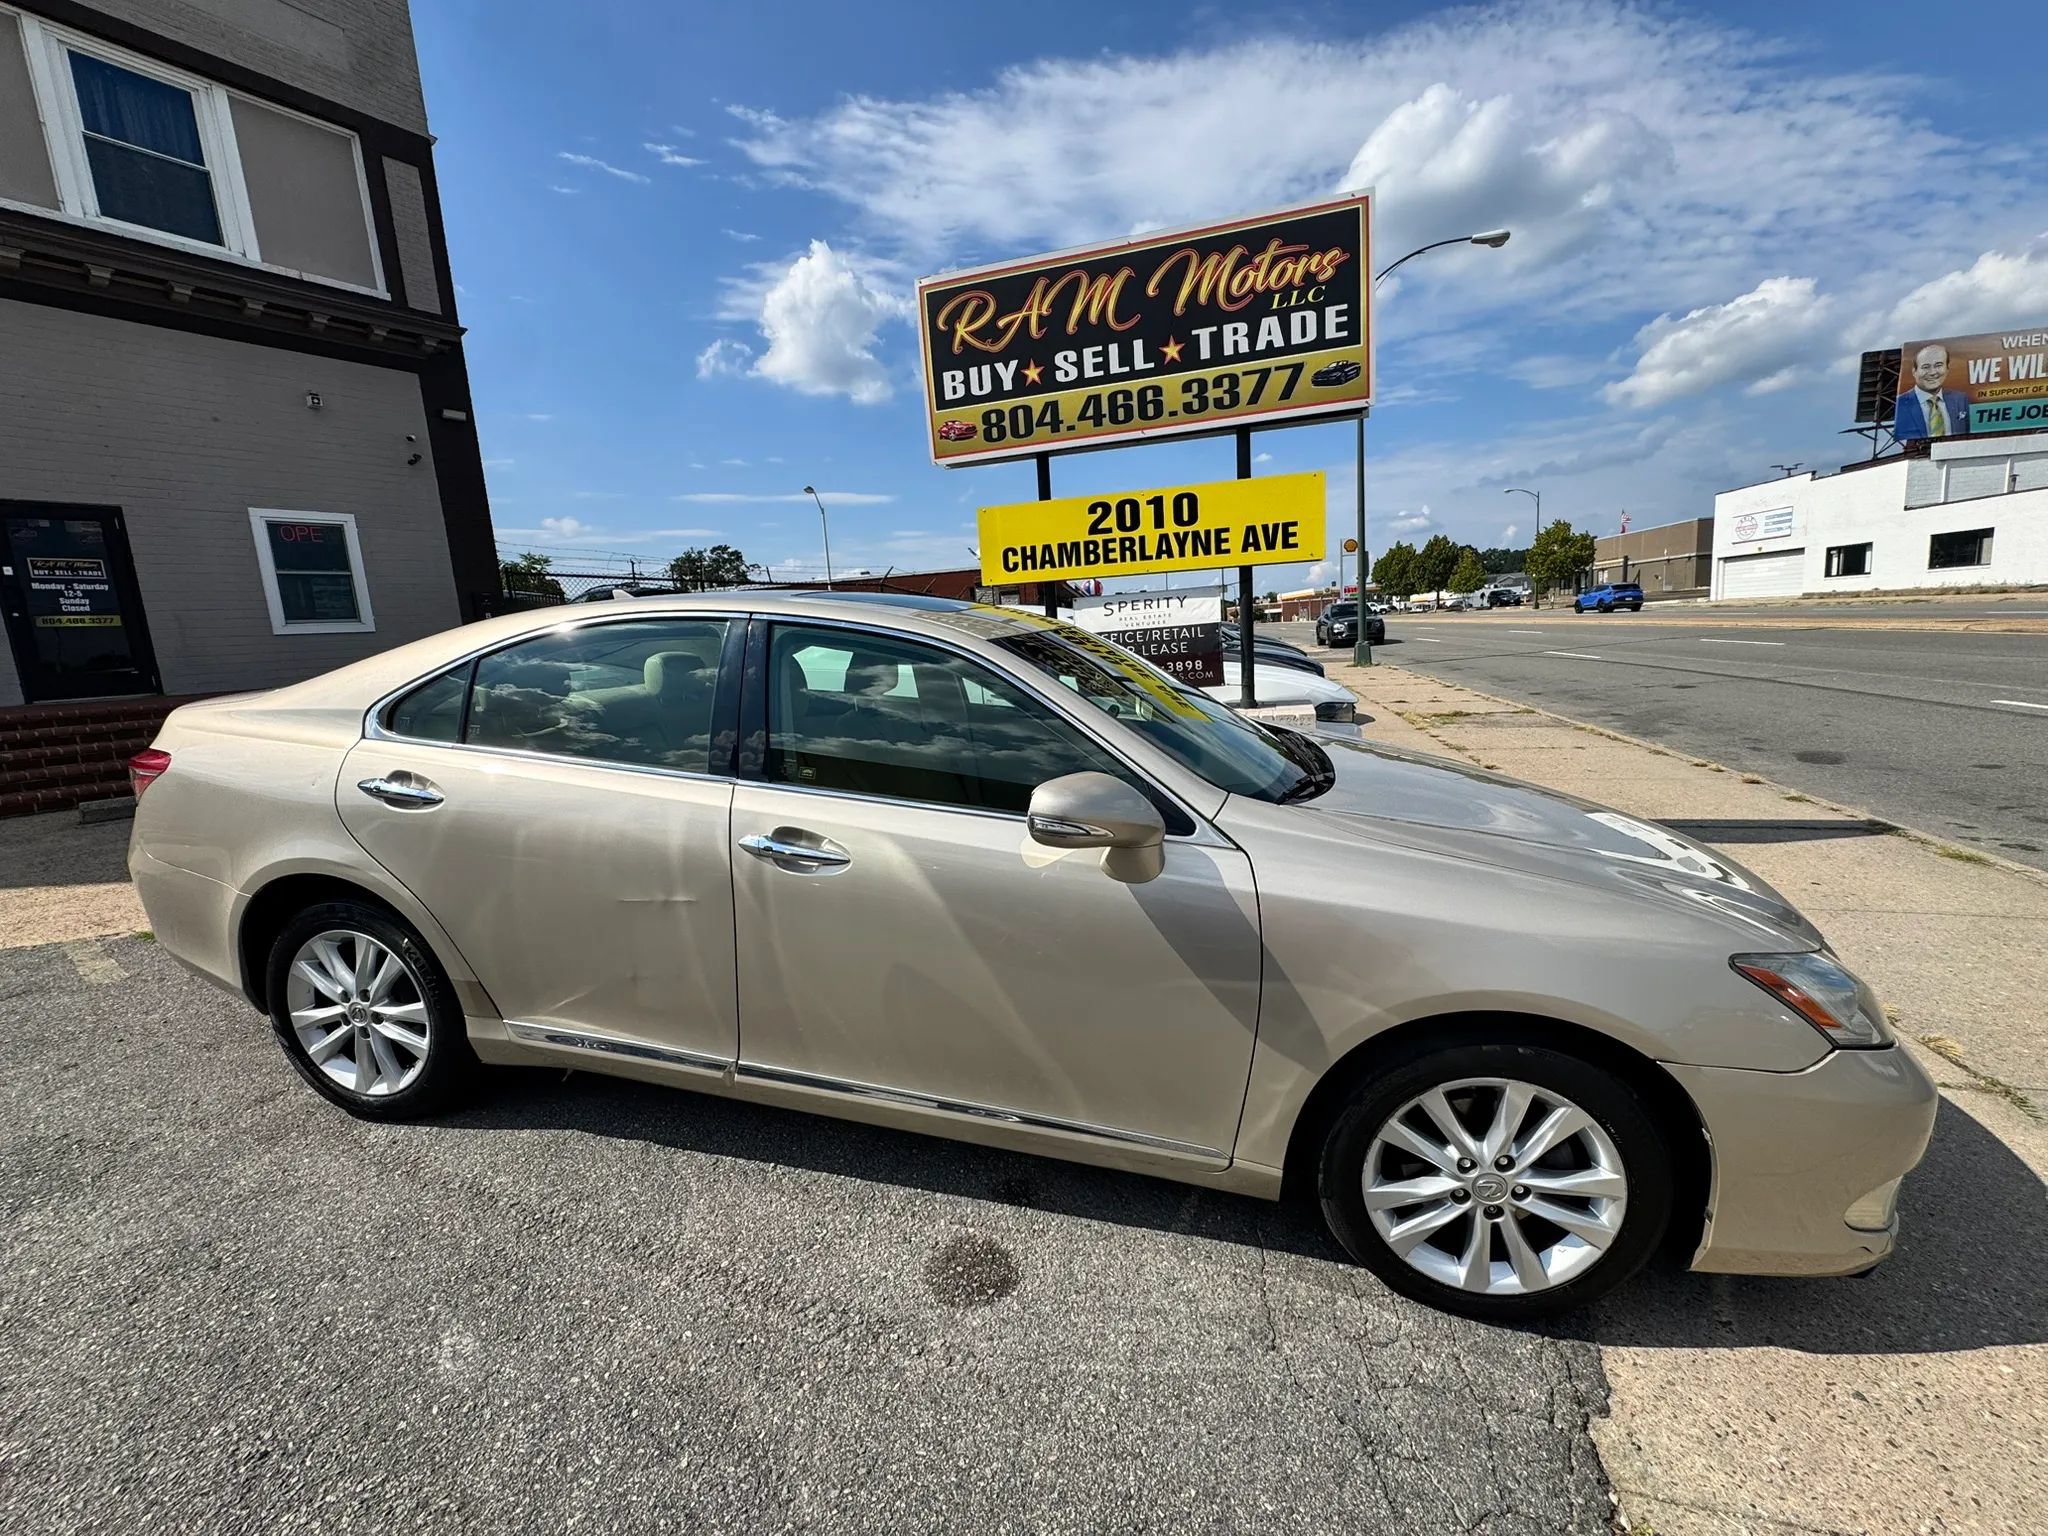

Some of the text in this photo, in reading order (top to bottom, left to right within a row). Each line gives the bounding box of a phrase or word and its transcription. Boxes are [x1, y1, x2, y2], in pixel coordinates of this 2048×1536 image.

[937, 238, 1350, 355] RAM Motors
[1269, 285, 1326, 310] LLC
[942, 303, 1349, 401] BUY SELL TRADE
[1968, 357, 2002, 385] WE
[981, 362, 1305, 444] 804.466.3377
[1989, 386, 2029, 397] SUPPORT
[2032, 385, 2044, 393] OF
[1976, 407, 2012, 423] THE
[1087, 492, 1199, 536] 2010
[1002, 521, 1299, 573] CHAMBERLAYNE AVE
[31, 582, 65, 590] Monday
[73, 583, 109, 591] Saturday
[59, 597, 89, 605] Sunday
[1103, 595, 1188, 617] SPERITY
[1142, 642, 1189, 656] LEASE
